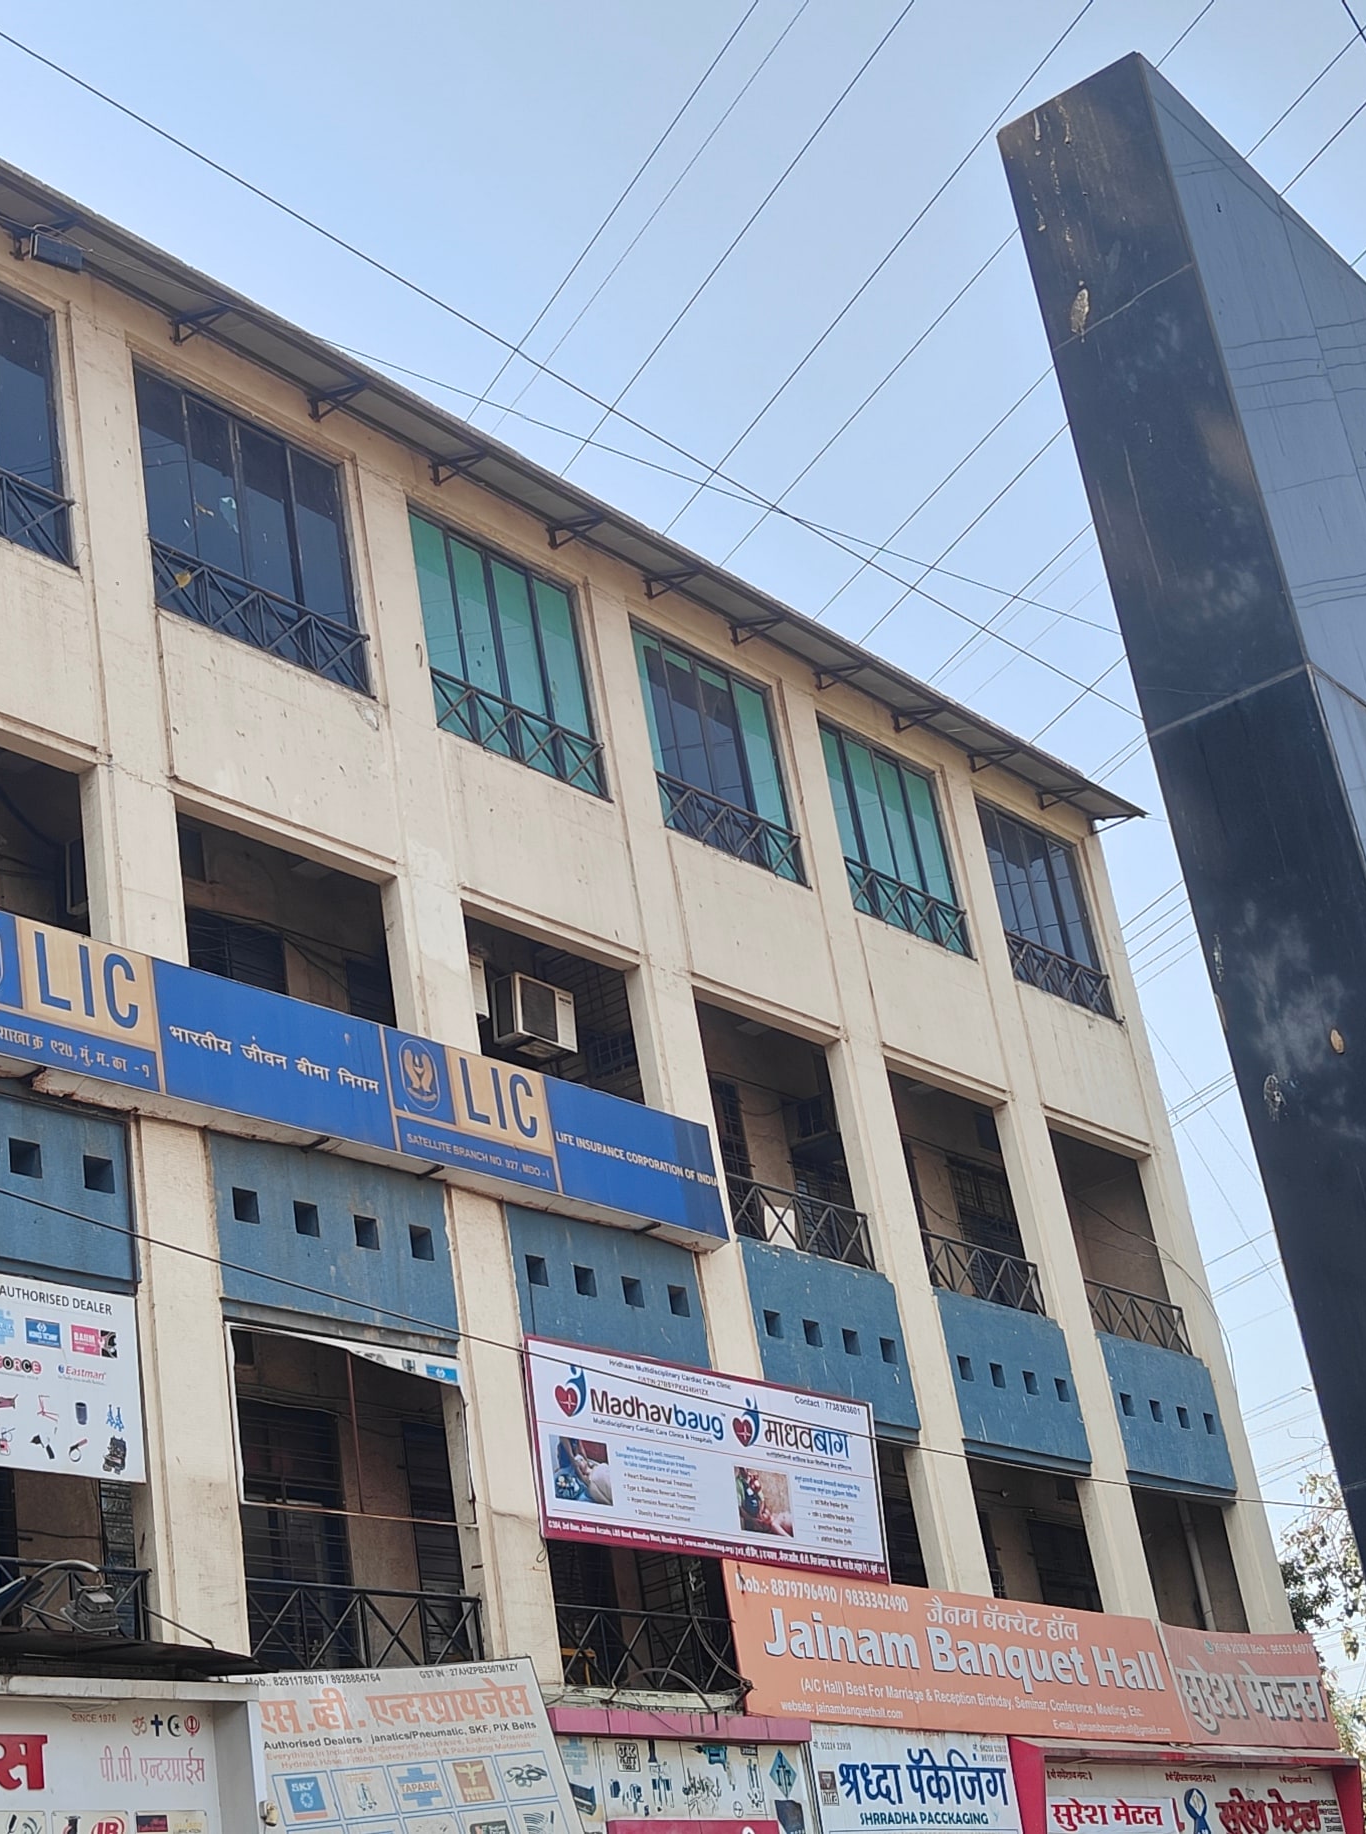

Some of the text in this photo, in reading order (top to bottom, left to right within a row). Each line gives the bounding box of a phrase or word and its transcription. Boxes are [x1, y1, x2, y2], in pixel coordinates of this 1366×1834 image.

[33, 930, 139, 1030] LIC
[169, 1025, 380, 1094] भारतीय जीवन बीमा निगम
[458, 1056, 539, 1139] LIC
[407, 1133, 452, 1153] SATELLITE
[453, 1145, 488, 1162] BRANCH
[555, 1131, 575, 1146] LIFE
[576, 1136, 625, 1161] INSURANCE
[626, 1151, 685, 1178] CORPORATION
[685, 1168, 695, 1180] OF
[0, 1284, 113, 1316] AUTHORISED DEALER
[66, 1365, 105, 1380] Eastman
[635, 1365, 732, 1390] Multidisciplinary Cardiac Care Clinic
[590, 1388, 725, 1441] Madhavbaug
[794, 1396, 820, 1409] Contact
[762, 1418, 850, 1459] माधवबाग
[924, 1595, 1078, 1641] जैनम हॉल
[764, 1607, 1167, 1695] Jainam Banquet Hall
[273, 1673, 381, 1686] 8291178076 8928864764
[800, 1677, 821, 1695] (A/C
[823, 1679, 845, 1697] Hall)
[846, 1681, 868, 1698] Best
[869, 1682, 884, 1698] For
[885, 1685, 925, 1704] Marriage
[925, 1690, 933, 1702] &
[934, 1690, 977, 1706] Reception
[977, 1693, 1013, 1710] Birthday,
[1014, 1696, 1050, 1712] Seminar,
[1050, 1699, 1097, 1716] Conference,
[1175, 1655, 1329, 1735] सुरेश मेटल्स
[71, 1713, 116, 1723] SINCE 1976
[780, 1700, 814, 1713] website:
[263, 1721, 537, 1750] Authorised Dealers SKF, PIX Belts
[399, 1781, 440, 1793] TAPARIA
[838, 1748, 1009, 1806] श्रध्दा पॅकेजिंग
[860, 1811, 989, 1826] SHRRADHA PACCKAGING
[1051, 1798, 1164, 1832] सुरेश मेटल
